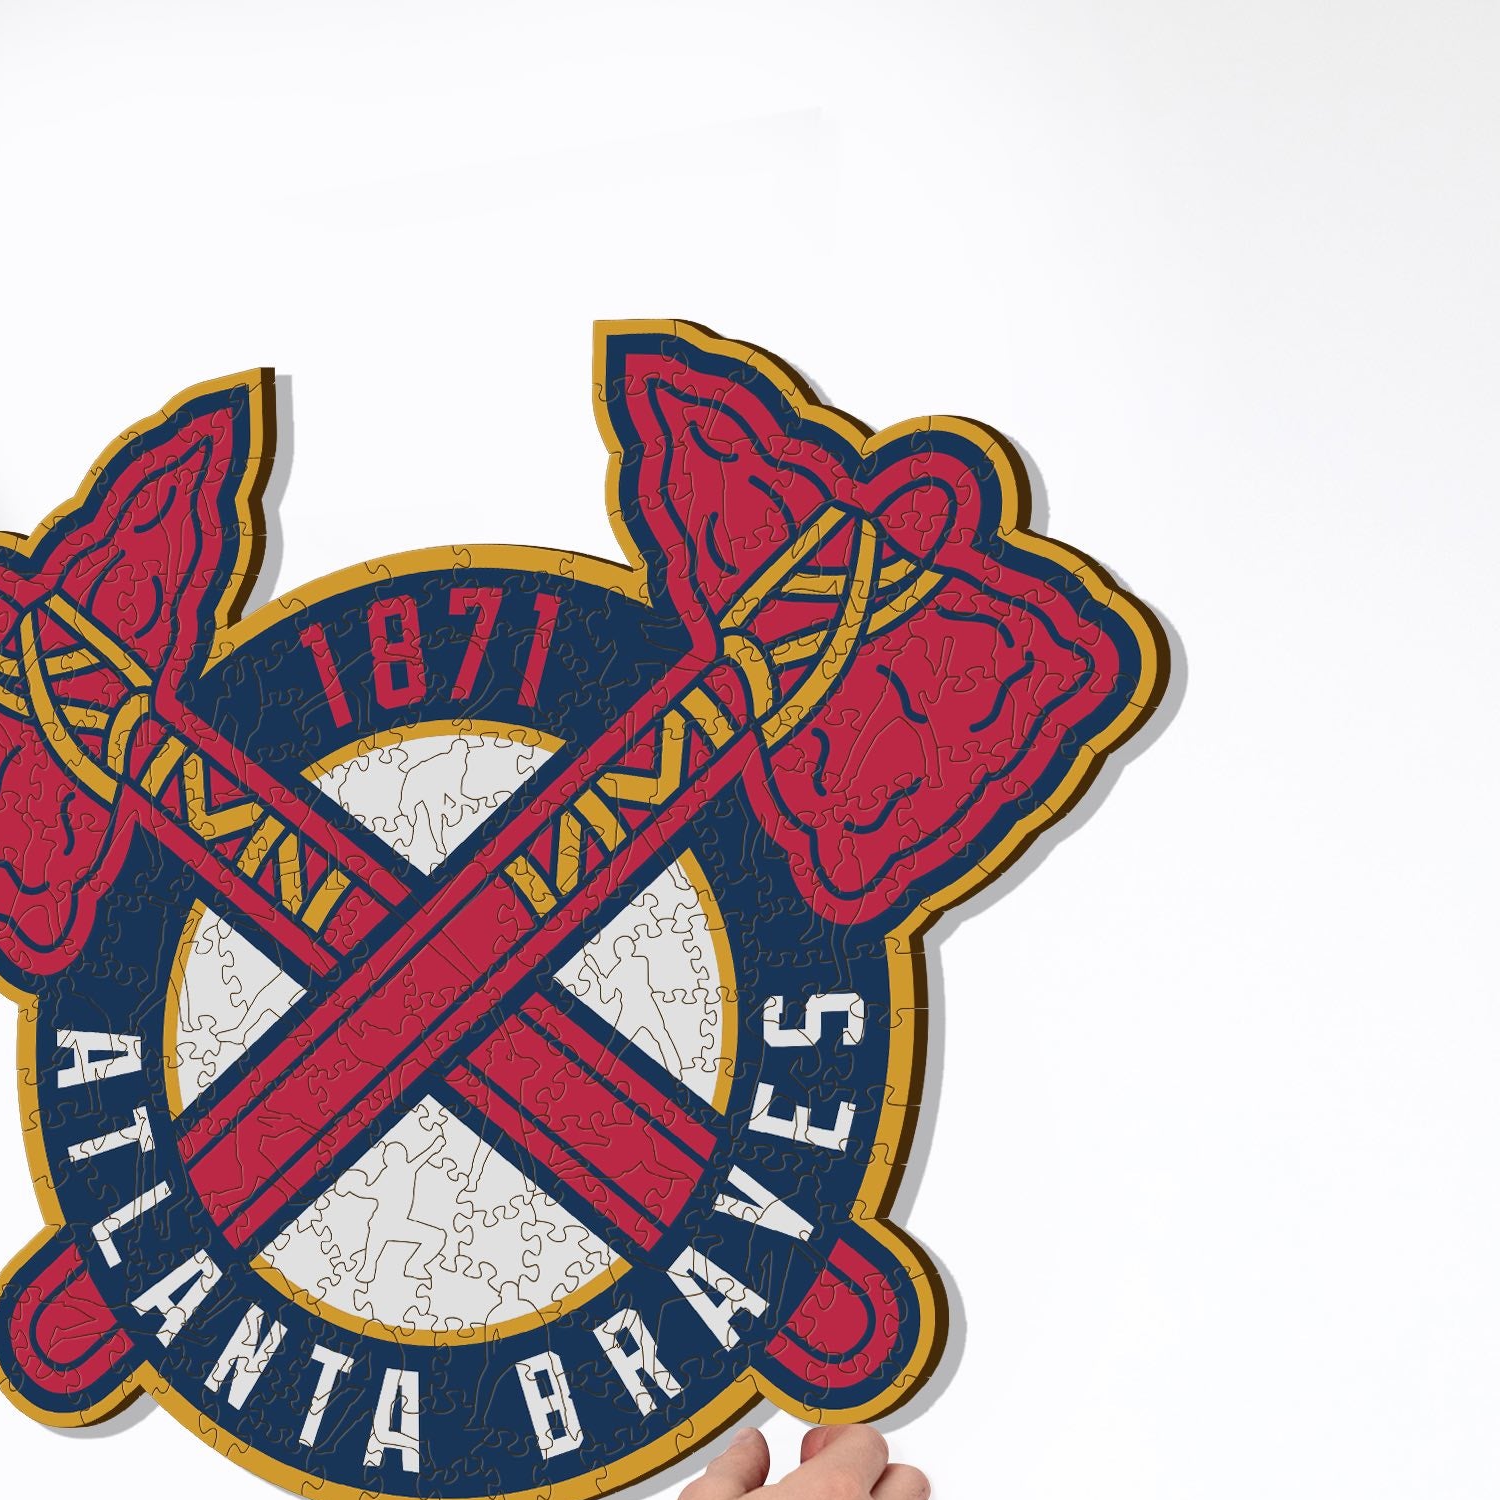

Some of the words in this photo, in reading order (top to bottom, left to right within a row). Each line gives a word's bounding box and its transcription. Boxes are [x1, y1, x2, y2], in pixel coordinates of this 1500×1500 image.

[300, 588, 561, 728] 1871
[57, 1029, 420, 1473] ATLANTA
[515, 991, 866, 1460] BRAVES
